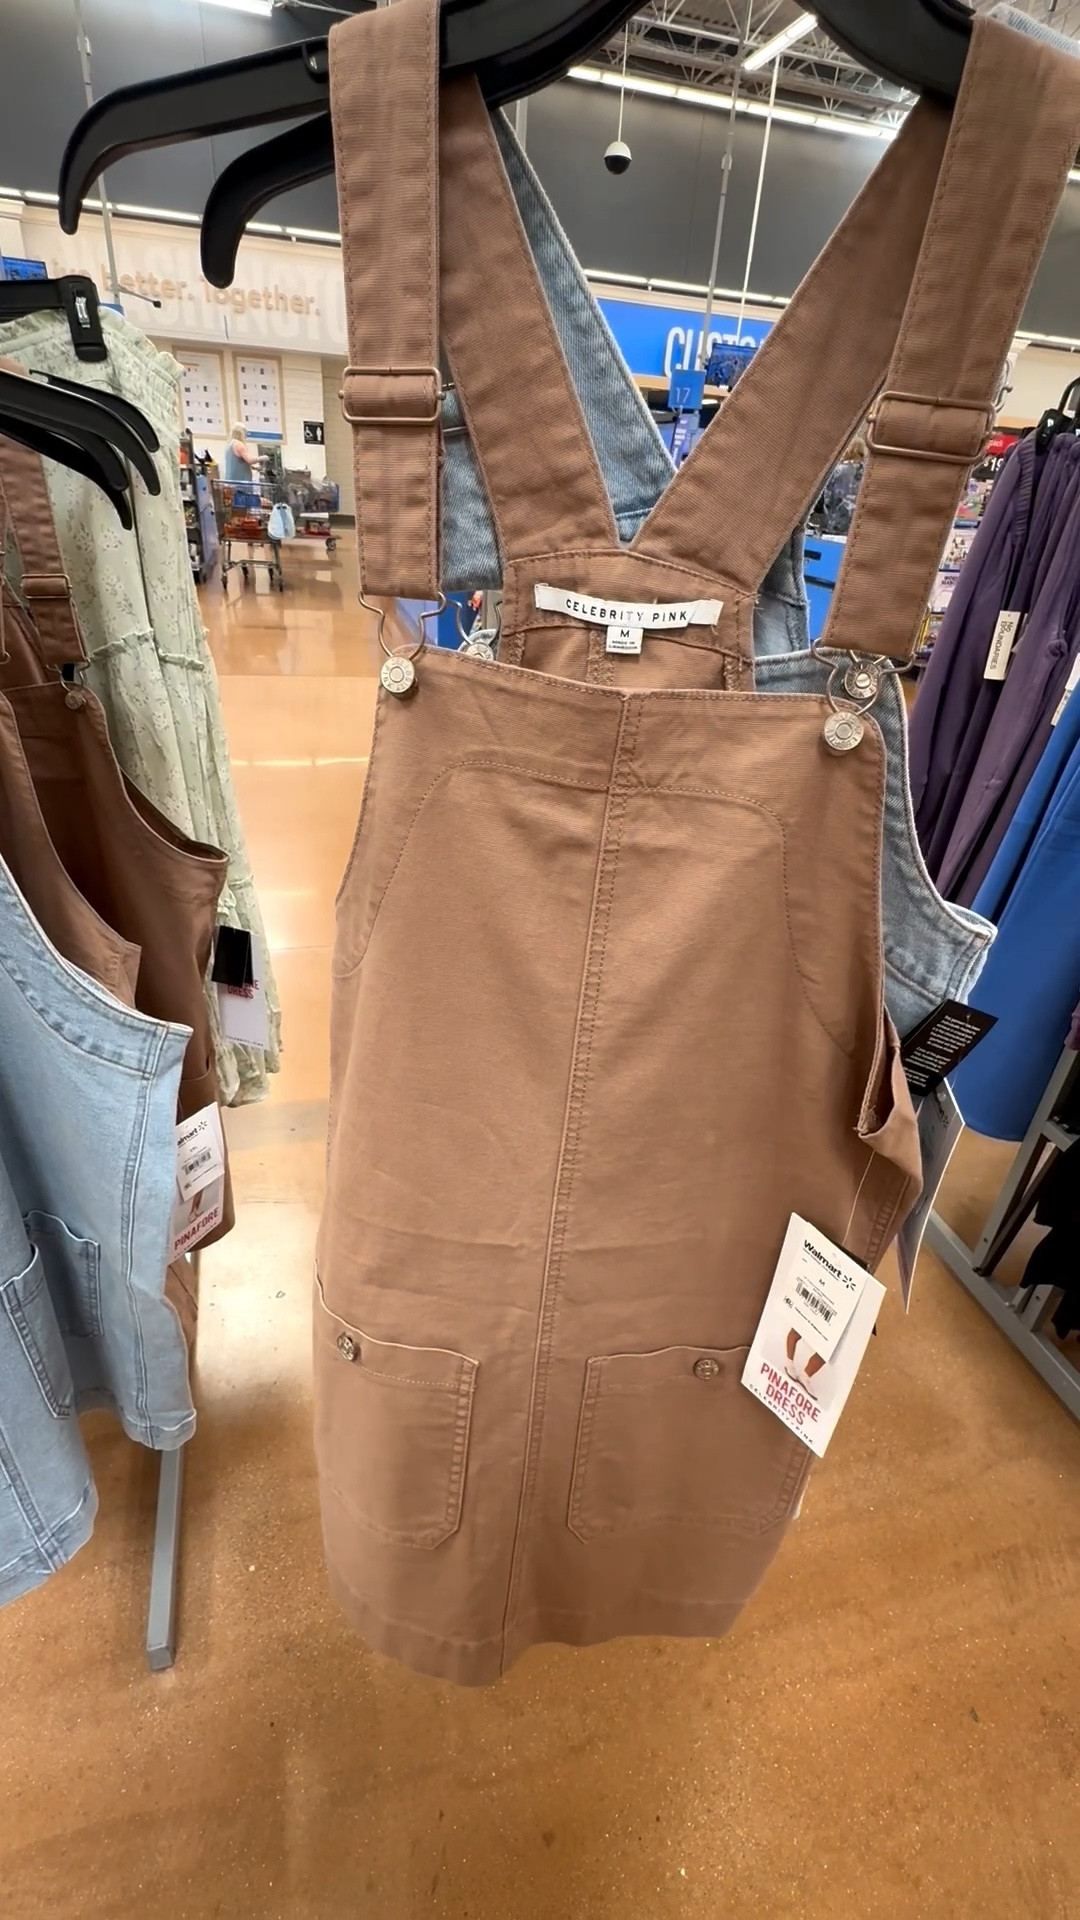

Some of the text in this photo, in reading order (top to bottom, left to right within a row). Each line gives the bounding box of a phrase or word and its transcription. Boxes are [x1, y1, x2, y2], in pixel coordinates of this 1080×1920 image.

[675, 387, 691, 403] 17
[566, 598, 687, 623] CELEBRITY PINK
[620, 629, 630, 638] M
[177, 1128, 198, 1146] almart
[174, 1206, 219, 1251] PINAFORE
[803, 1239, 843, 1279] Walmart
[760, 1362, 822, 1423] PINAFORE
[766, 1384, 806, 1426] DRESS
